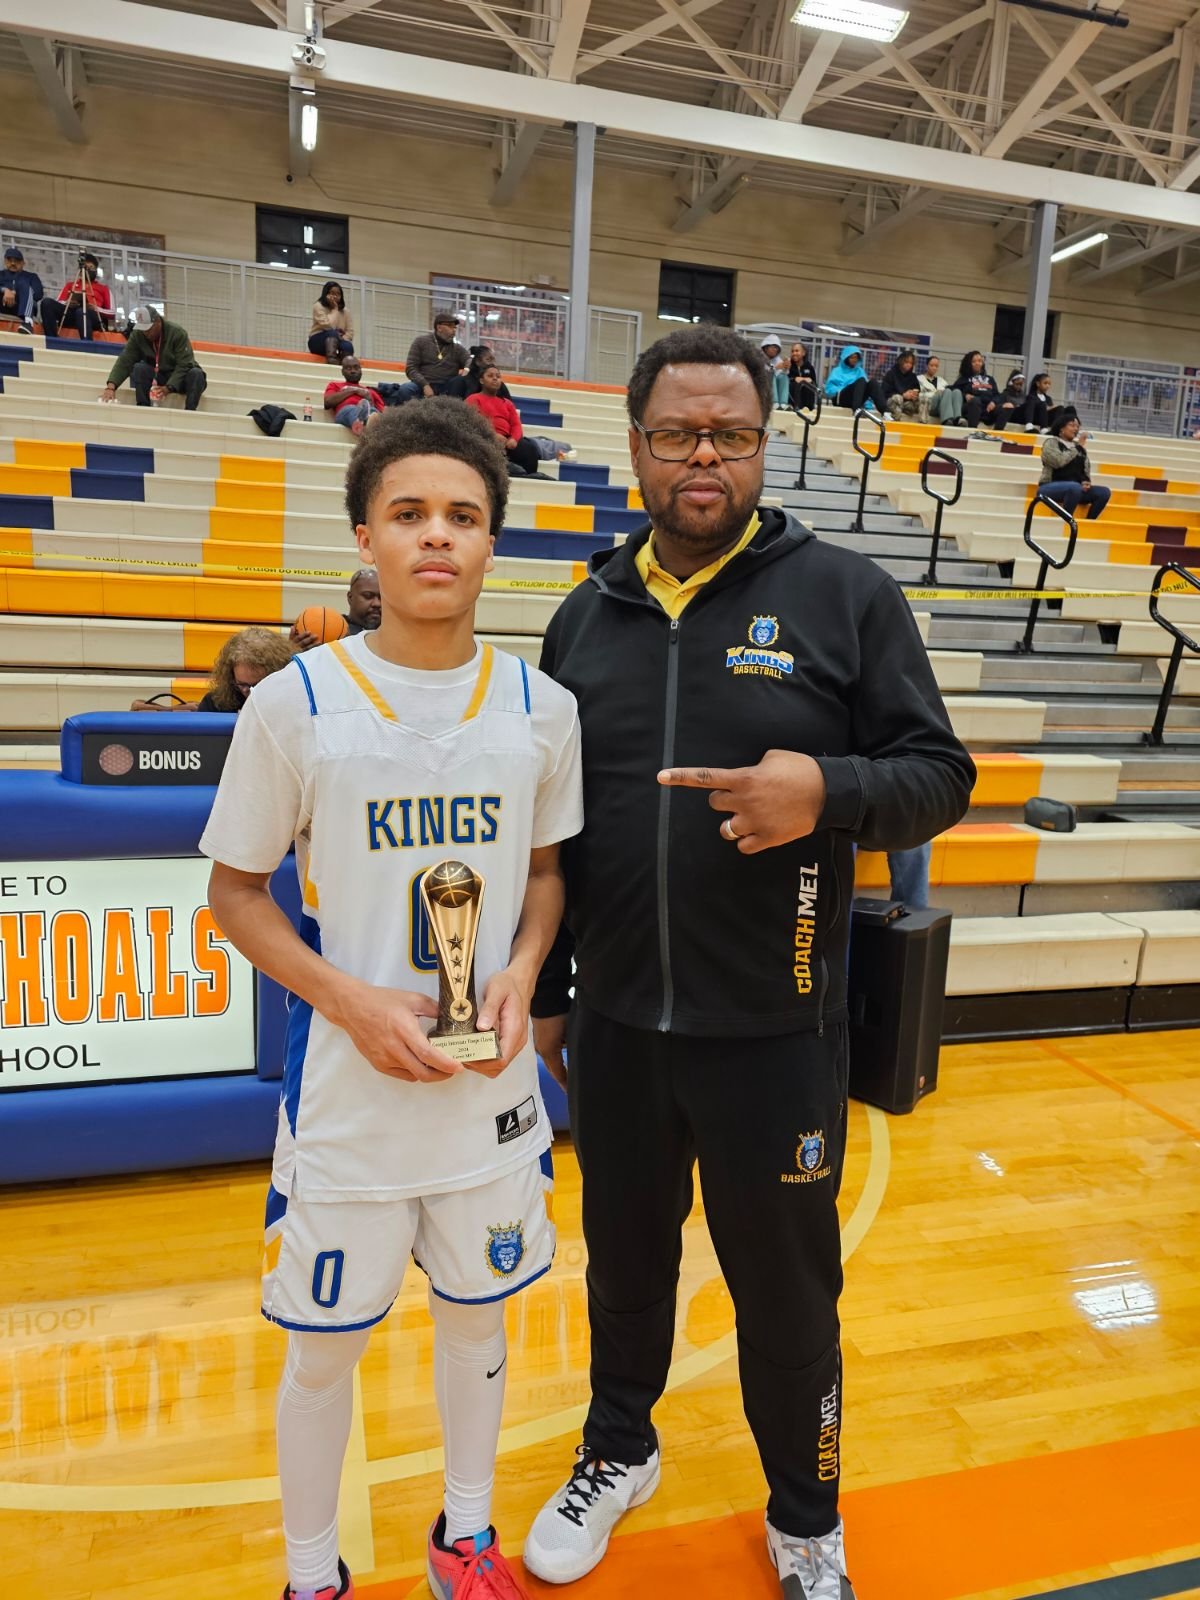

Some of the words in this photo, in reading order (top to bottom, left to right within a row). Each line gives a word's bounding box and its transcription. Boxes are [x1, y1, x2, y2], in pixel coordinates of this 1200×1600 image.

[726, 646, 794, 674] KINGS
[733, 665, 783, 680] BASKETBALL
[139, 750, 201, 770] BONUS
[366, 794, 503, 852] KINGS
[27, 875, 67, 896] TO
[312, 1248, 345, 1309] 0
